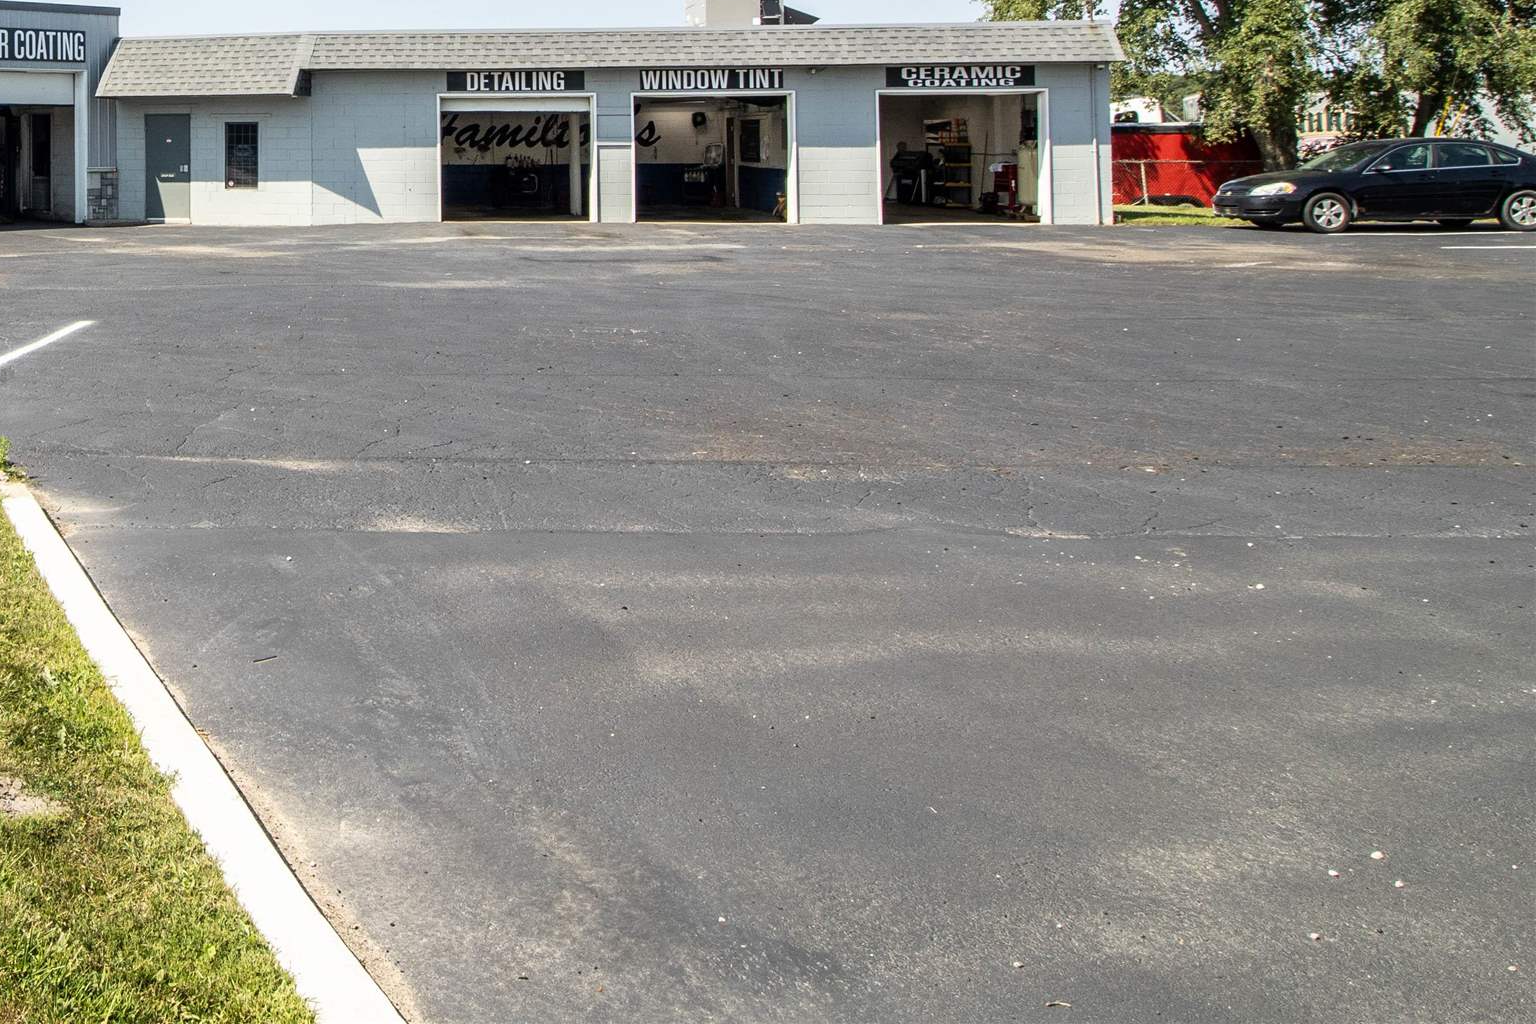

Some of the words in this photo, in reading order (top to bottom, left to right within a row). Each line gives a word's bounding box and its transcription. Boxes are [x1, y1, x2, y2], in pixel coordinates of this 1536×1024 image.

[14, 29, 85, 61] COATING
[466, 71, 565, 91] DETAILING
[641, 69, 729, 90] WINDOW
[736, 68, 782, 89] TINT
[901, 66, 1022, 79] CERAMIC
[907, 78, 1015, 87] COATING
